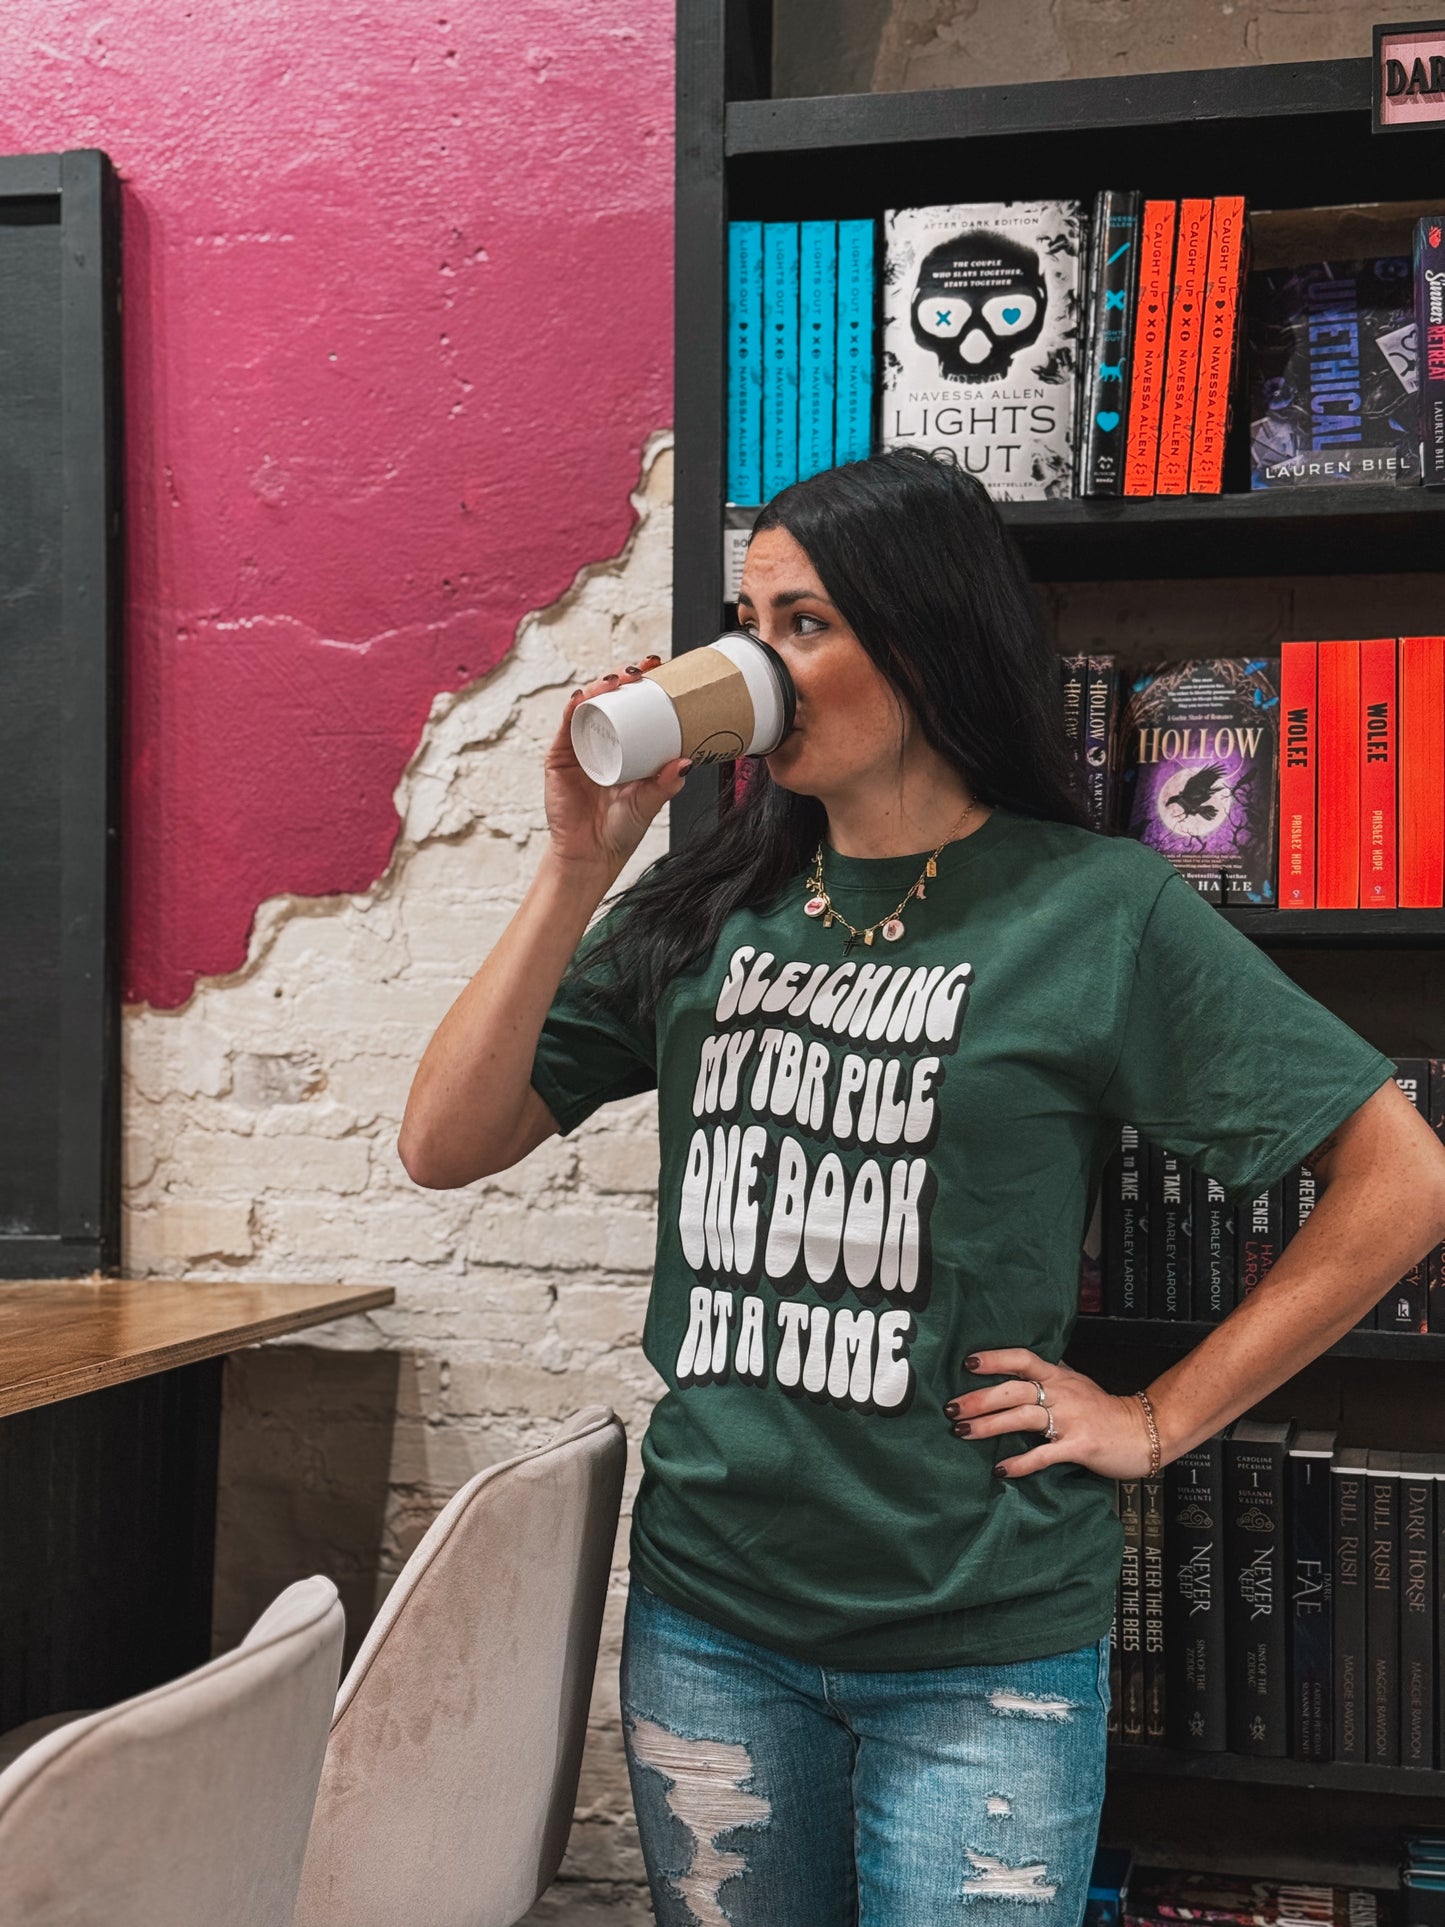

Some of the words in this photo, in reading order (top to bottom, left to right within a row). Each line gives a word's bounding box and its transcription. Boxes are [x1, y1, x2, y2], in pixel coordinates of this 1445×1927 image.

[923, 221, 957, 231] AFTER
[961, 220, 990, 229] DARK
[994, 218, 1040, 228] EDITION
[1219, 217, 1233, 272] CAUGHT
[739, 239, 748, 285] LIGHTS
[775, 240, 785, 285] LIGHTS
[813, 239, 822, 284] LIGHTS
[851, 237, 861, 284] LIGHTS
[970, 259, 1002, 268] COUPLE
[1151, 222, 1164, 277] CAUGHT
[1187, 221, 1200, 275] CAUGHT
[932, 271, 952, 279] WHO
[952, 270, 978, 278] SLAYS
[943, 280, 969, 288] STAYS
[970, 279, 1012, 288] TOGETHER
[1149, 280, 1160, 298] UP
[1185, 279, 1195, 297] UP
[1217, 276, 1228, 294] UP
[739, 288, 748, 315] OUT
[775, 289, 785, 316] OUT
[813, 288, 822, 316] OUT
[850, 287, 860, 315] OUT
[1308, 277, 1362, 452] UNETHICAL
[1426, 325, 1445, 382] RETREAT
[738, 366, 748, 425] NAVESSA
[775, 367, 784, 425] NAVESSA
[811, 366, 820, 425] NAVESSA
[849, 365, 859, 423] NAVESSA
[909, 390, 984, 402] NAVESSA
[992, 388, 1045, 400] ALLEN
[1141, 350, 1154, 411] NAVESSA
[1174, 349, 1188, 410] NAVESSA
[1206, 346, 1221, 407] NAVESSA
[896, 405, 1056, 438] LIGHTS
[1138, 414, 1149, 457] ALLEN
[1171, 414, 1182, 456] ALLEN
[1203, 411, 1216, 454] ALLEN
[1433, 401, 1445, 445] LAUREN
[738, 428, 748, 467] ALLEN
[774, 429, 784, 468] ALLEN
[811, 428, 820, 468] ALLEN
[930, 444, 1022, 474] OUT
[1265, 460, 1352, 480] LAUREN
[1362, 457, 1412, 472] BIEL
[1434, 447, 1445, 472] BIEL
[1089, 679, 1109, 741] HOLLOW
[1136, 726, 1264, 764] HOLLOW
[1291, 814, 1303, 850] PAISLEY
[1372, 810, 1383, 846] PAISLEY
[1291, 852, 1302, 876] HOPE
[1372, 849, 1383, 872] HOPE
[1198, 880, 1252, 892] HALE
[715, 945, 972, 1046] SLEIGHING
[692, 1028, 757, 1119] MY
[749, 1026, 830, 1145] TBR
[831, 1054, 942, 1145] PILE
[1121, 1125, 1139, 1153] OUL
[1121, 1170, 1139, 1202] TAKE
[1163, 1172, 1181, 1205] TAKE
[1207, 1176, 1225, 1203] AKE
[678, 1124, 768, 1279] ONE
[763, 1134, 928, 1294] BOOK
[1122, 1208, 1135, 1253] HARLEY
[1252, 1190, 1269, 1234] VENGE
[1165, 1212, 1176, 1260] HARLEY
[1209, 1210, 1220, 1258] HARLEY
[1121, 1256, 1135, 1310] LAROUX
[1165, 1263, 1177, 1313] LAROUX
[1209, 1262, 1221, 1312] LAROUX
[675, 1286, 736, 1382] AT
[734, 1294, 766, 1379] A
[776, 1299, 912, 1410] TIME
[1190, 1469, 1198, 1485] 1
[1236, 1455, 1273, 1464] CAROLINE
[1251, 1472, 1259, 1488] 1
[1339, 1480, 1359, 1528] BULL
[1373, 1483, 1392, 1531] BULL
[1405, 1486, 1427, 1540] DARK
[1122, 1545, 1139, 1588] AFTER
[1145, 1546, 1162, 1588] AFTER
[1177, 1564, 1194, 1599] KEEP
[1188, 1541, 1213, 1618] NEVER
[1336, 1536, 1359, 1586] RUSH
[1369, 1539, 1392, 1591] RUSH
[1405, 1549, 1427, 1613] HORSE
[1122, 1590, 1139, 1617] THE
[1145, 1591, 1162, 1618] THE
[1238, 1567, 1255, 1603] KEEP
[1249, 1545, 1275, 1622] NEVER
[1291, 1558, 1323, 1617] FAE
[1122, 1619, 1140, 1652] BEES
[1145, 1620, 1163, 1653] BEES
[1256, 1643, 1268, 1663] SINS
[1246, 1651, 1257, 1687] ZODIAC
[1256, 1664, 1268, 1677] OF
[1256, 1678, 1268, 1695] THE
[1343, 1655, 1355, 1699] MAGGIE
[1375, 1658, 1387, 1705] MAGGIE
[1410, 1661, 1421, 1708] MAGGIE
[1343, 1701, 1355, 1752] RAWDON
[1375, 1704, 1387, 1756] RAWDON
[1410, 1708, 1422, 1759] RAWDON
